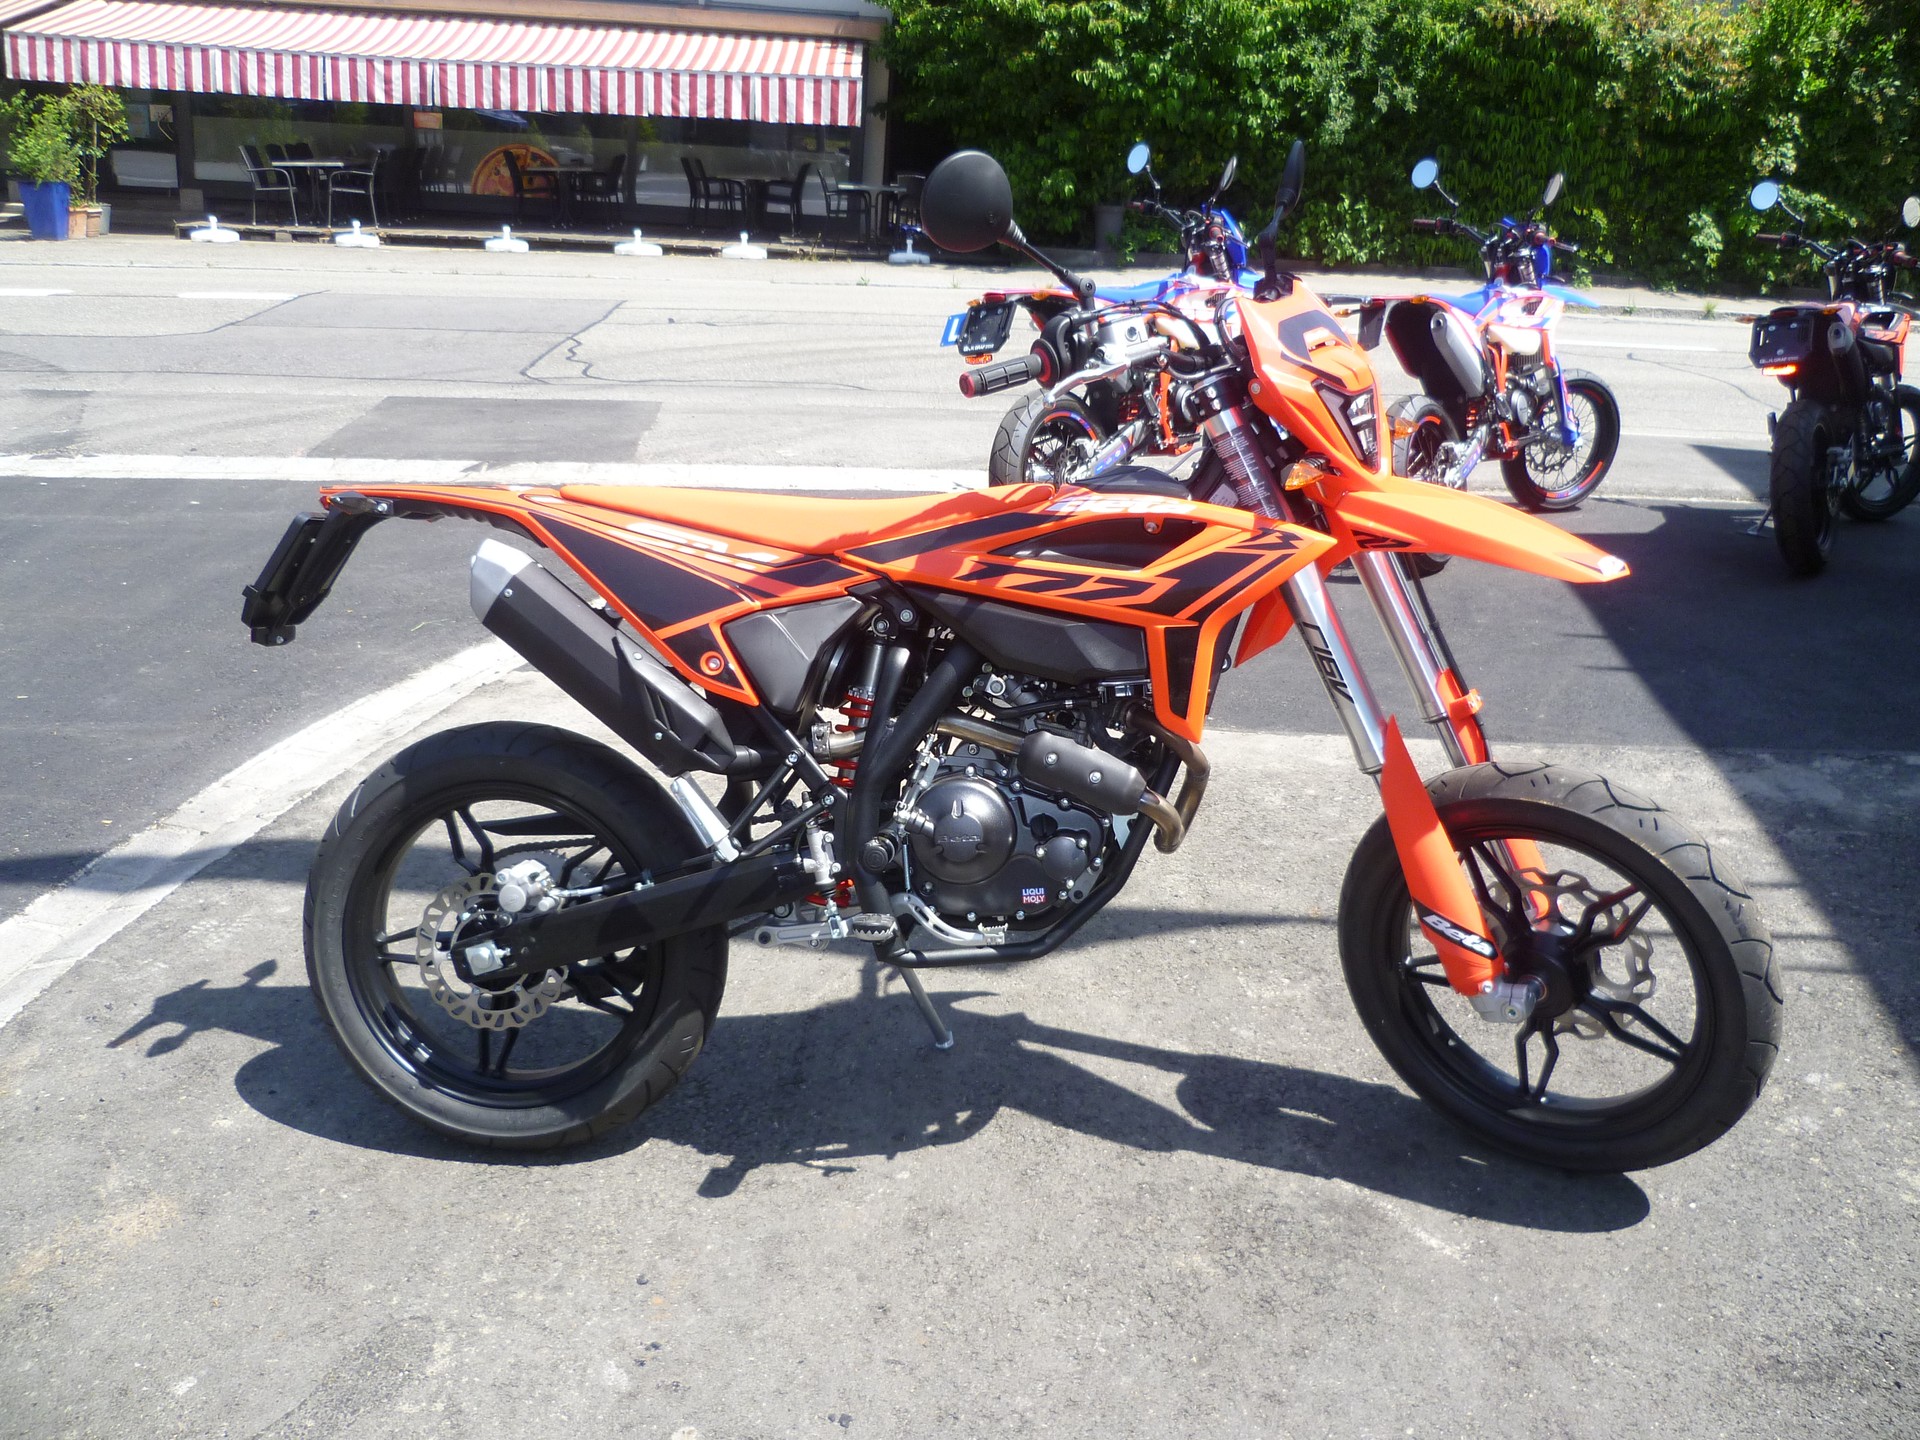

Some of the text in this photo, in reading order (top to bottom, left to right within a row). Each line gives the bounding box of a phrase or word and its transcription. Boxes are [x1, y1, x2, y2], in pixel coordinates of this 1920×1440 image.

[947, 318, 960, 343] L
[1022, 887, 1044, 896] LIQUI
[1023, 895, 1046, 904] MOLY
[1422, 914, 1493, 956] Beta
